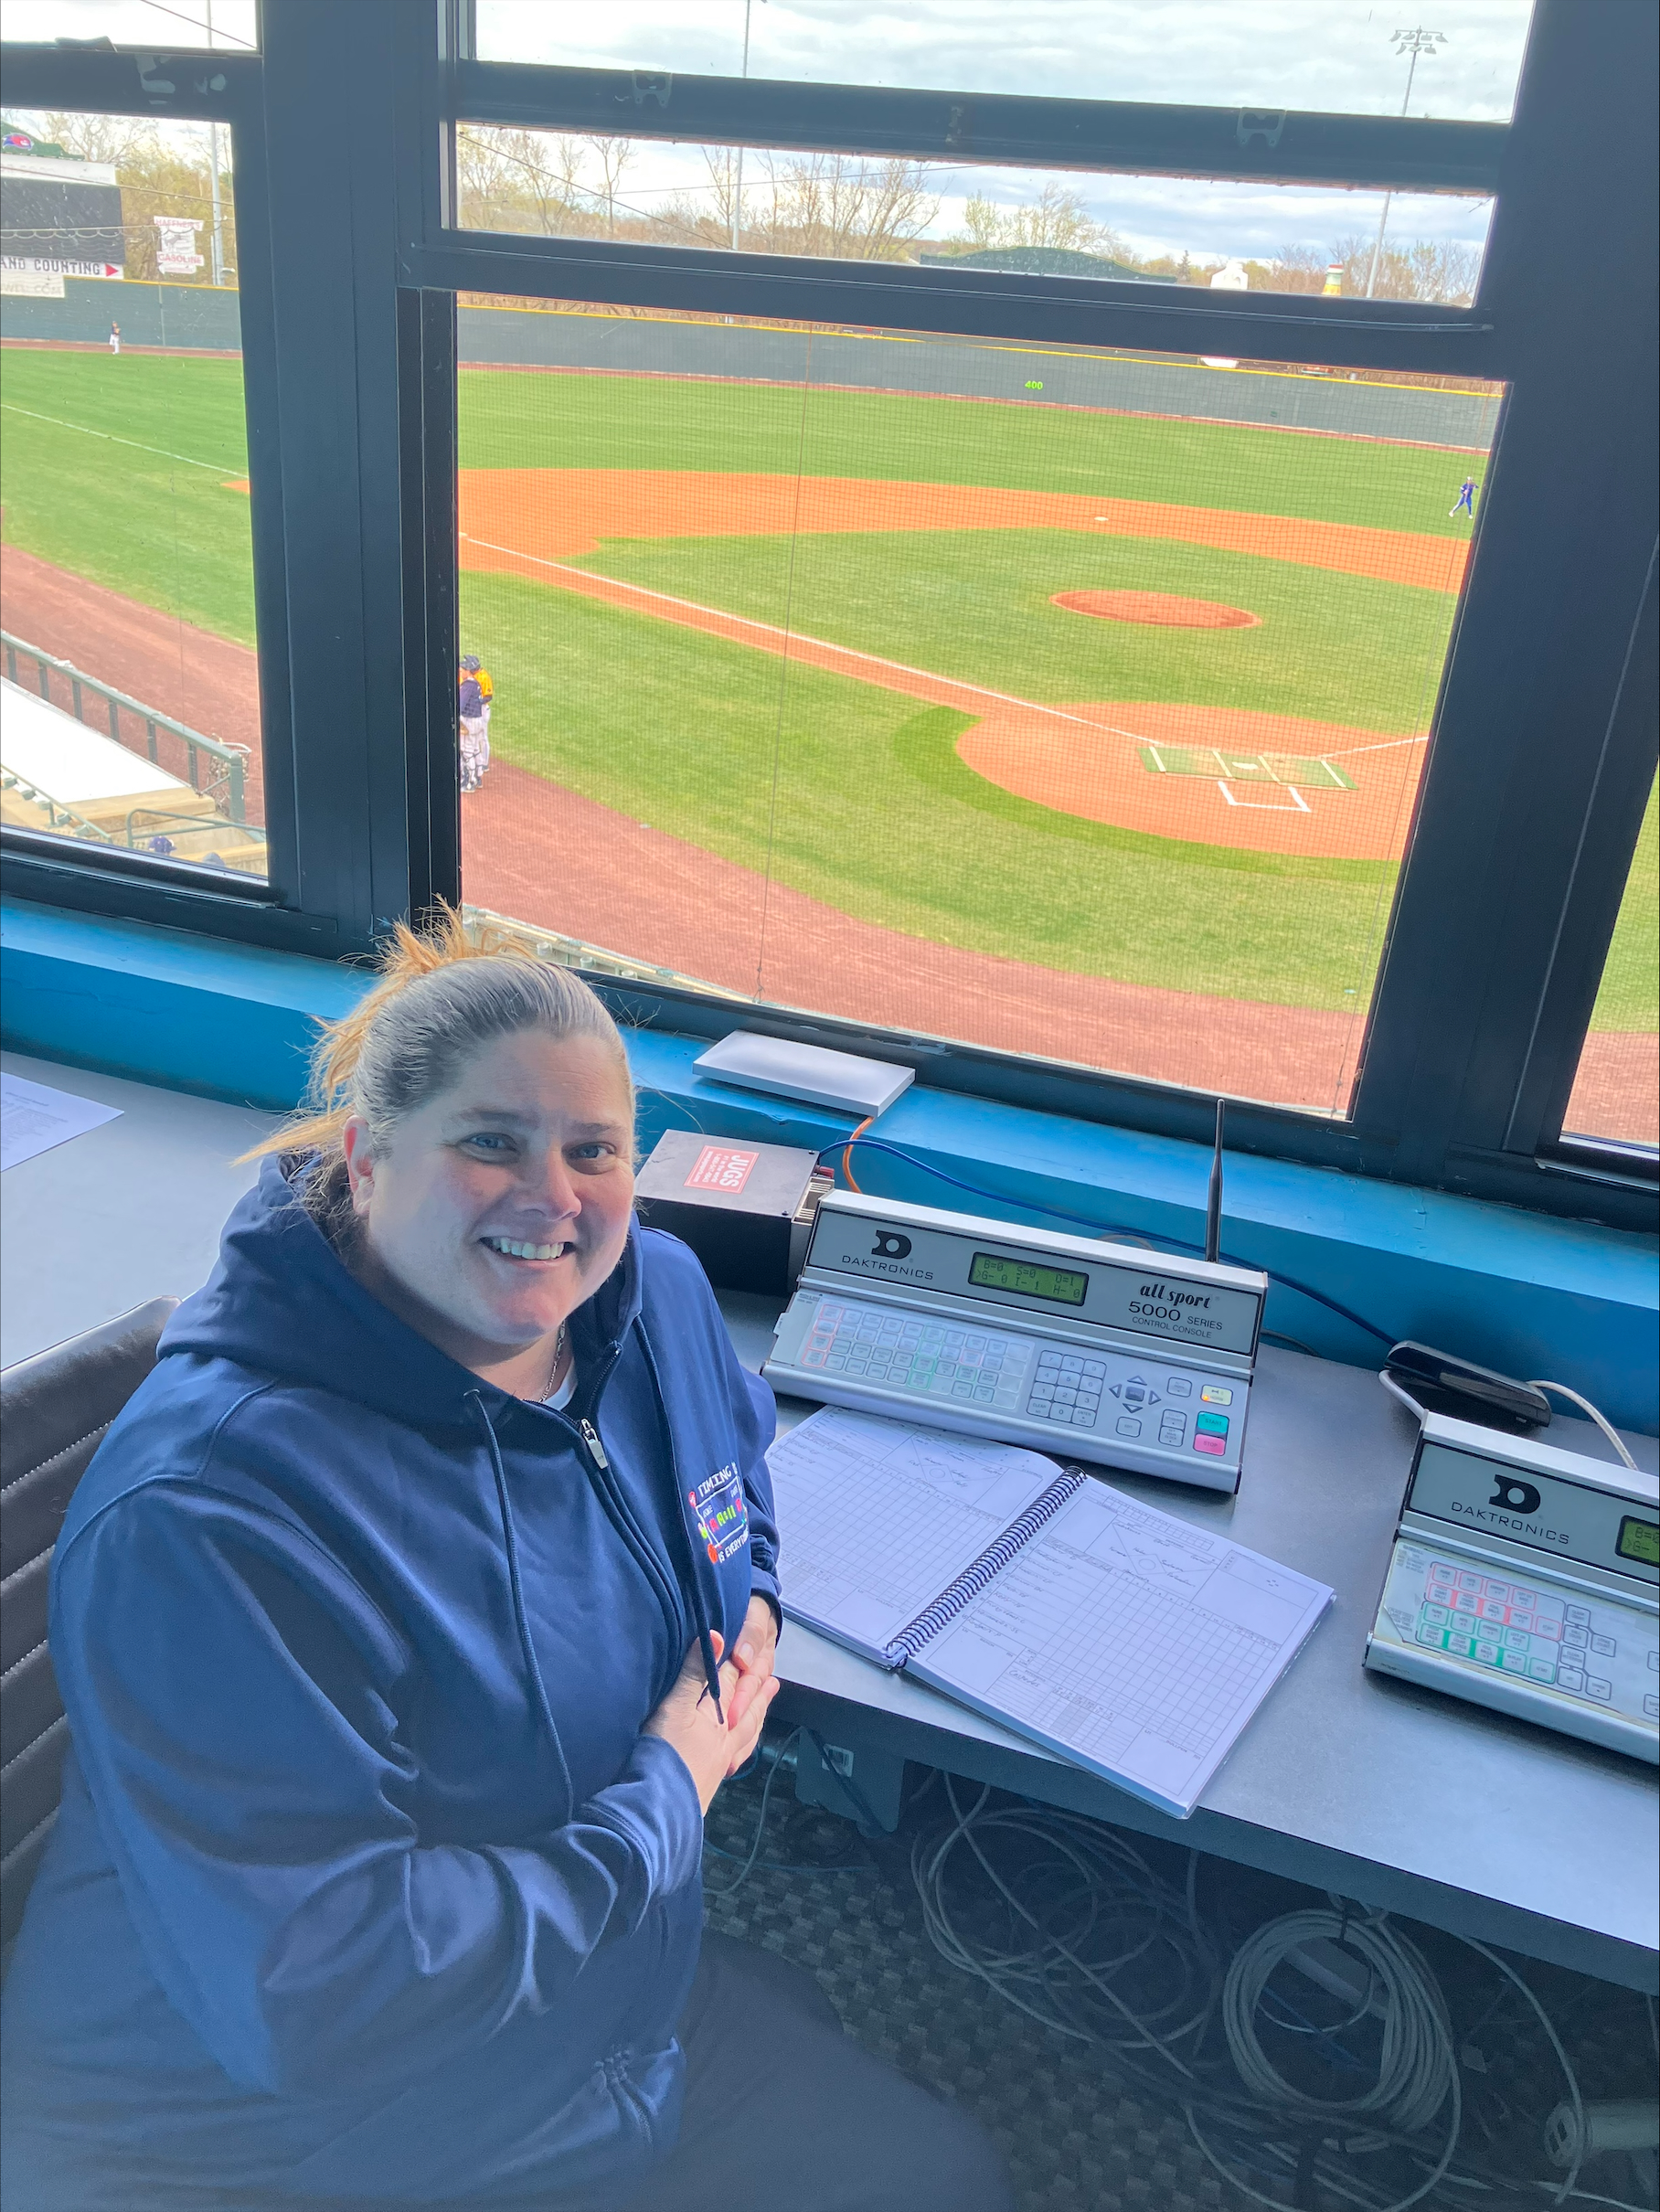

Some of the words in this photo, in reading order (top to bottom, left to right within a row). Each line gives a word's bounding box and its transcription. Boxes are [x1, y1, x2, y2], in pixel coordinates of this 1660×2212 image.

[1, 257, 26, 270] AND
[34, 259, 101, 275] COUNTING
[157, 253, 202, 264] GASOLINE
[1025, 380, 1043, 390] 400
[719, 1154, 750, 1187] JUGS
[841, 1255, 934, 1281] DAKTRONICS
[984, 1260, 1004, 1271] B=0
[1016, 1266, 1037, 1279] S=0
[1140, 1283, 1165, 1299] all
[1167, 1291, 1211, 1309] sport
[1128, 1301, 1181, 1322] 5000
[1186, 1316, 1223, 1331] SERIES
[1132, 1316, 1170, 1330] CONTROL
[1172, 1324, 1212, 1338] CONSOLE
[1204, 1418, 1222, 1426] START
[697, 1465, 732, 1497] TIMING
[1451, 1501, 1570, 1546] DAKTRONICS
[718, 1551, 726, 1564] IS
